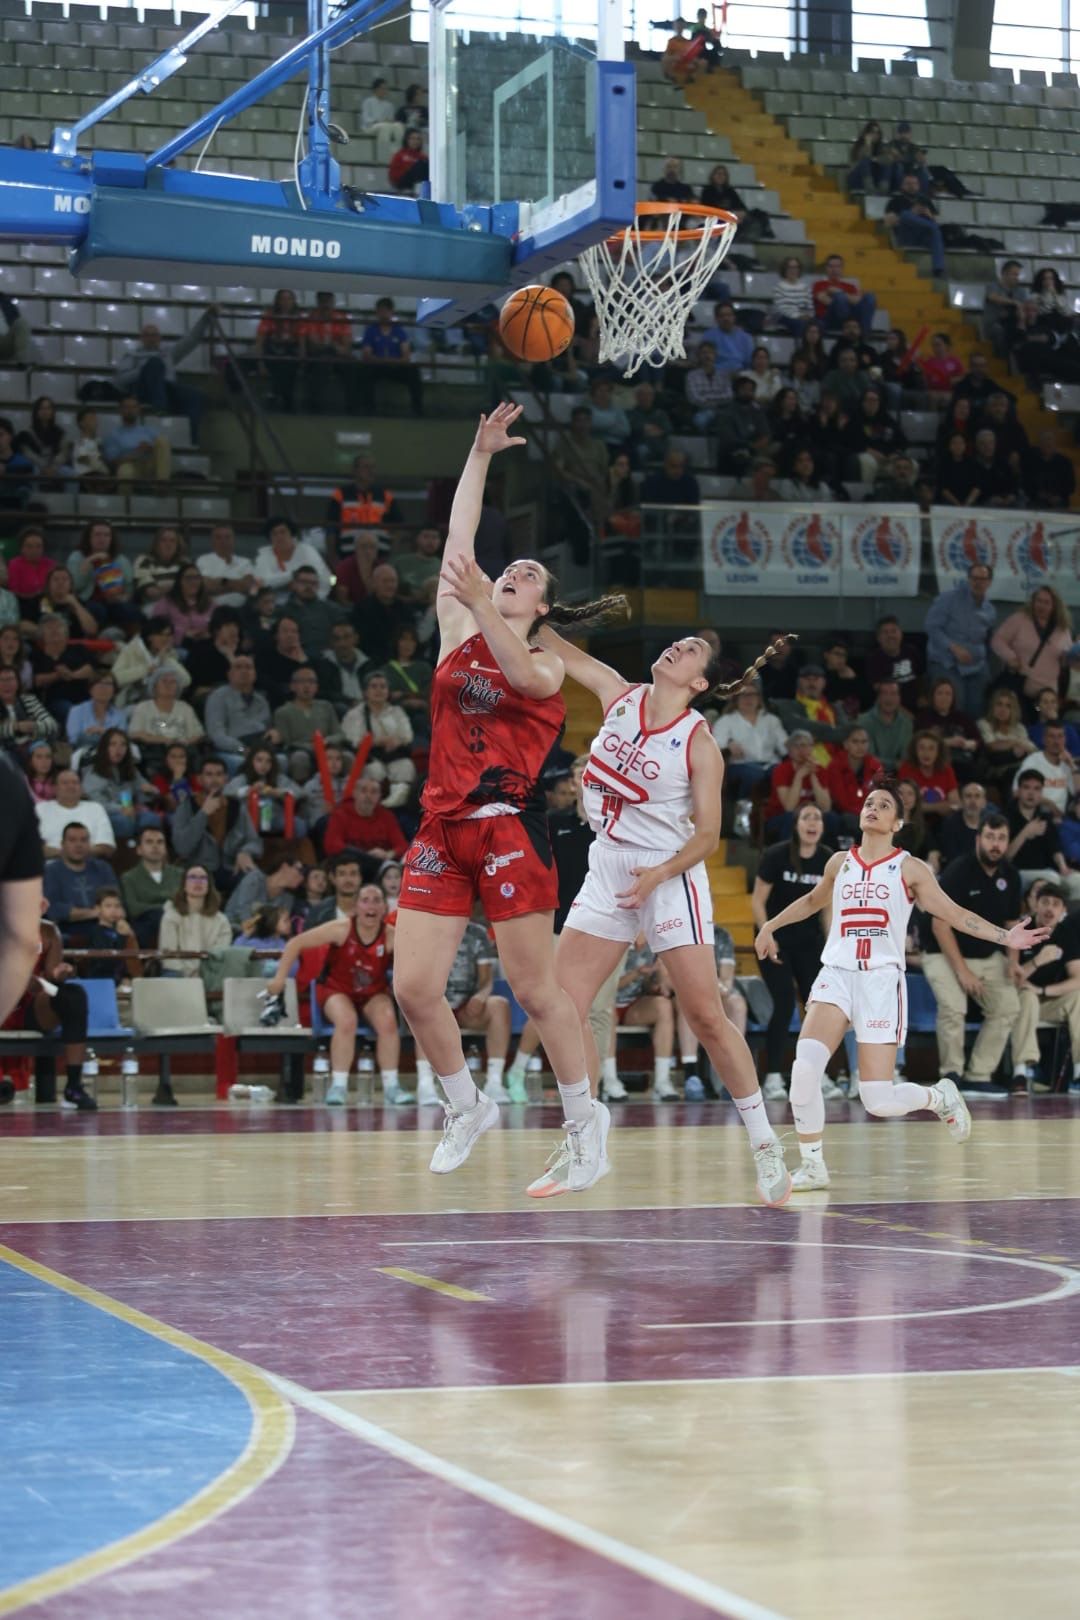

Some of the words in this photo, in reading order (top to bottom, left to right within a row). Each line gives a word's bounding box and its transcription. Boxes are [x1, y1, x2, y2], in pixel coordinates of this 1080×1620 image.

[251, 235, 341, 259] MONDO
[601, 795, 623, 821] 14
[856, 938, 871, 960] 10
